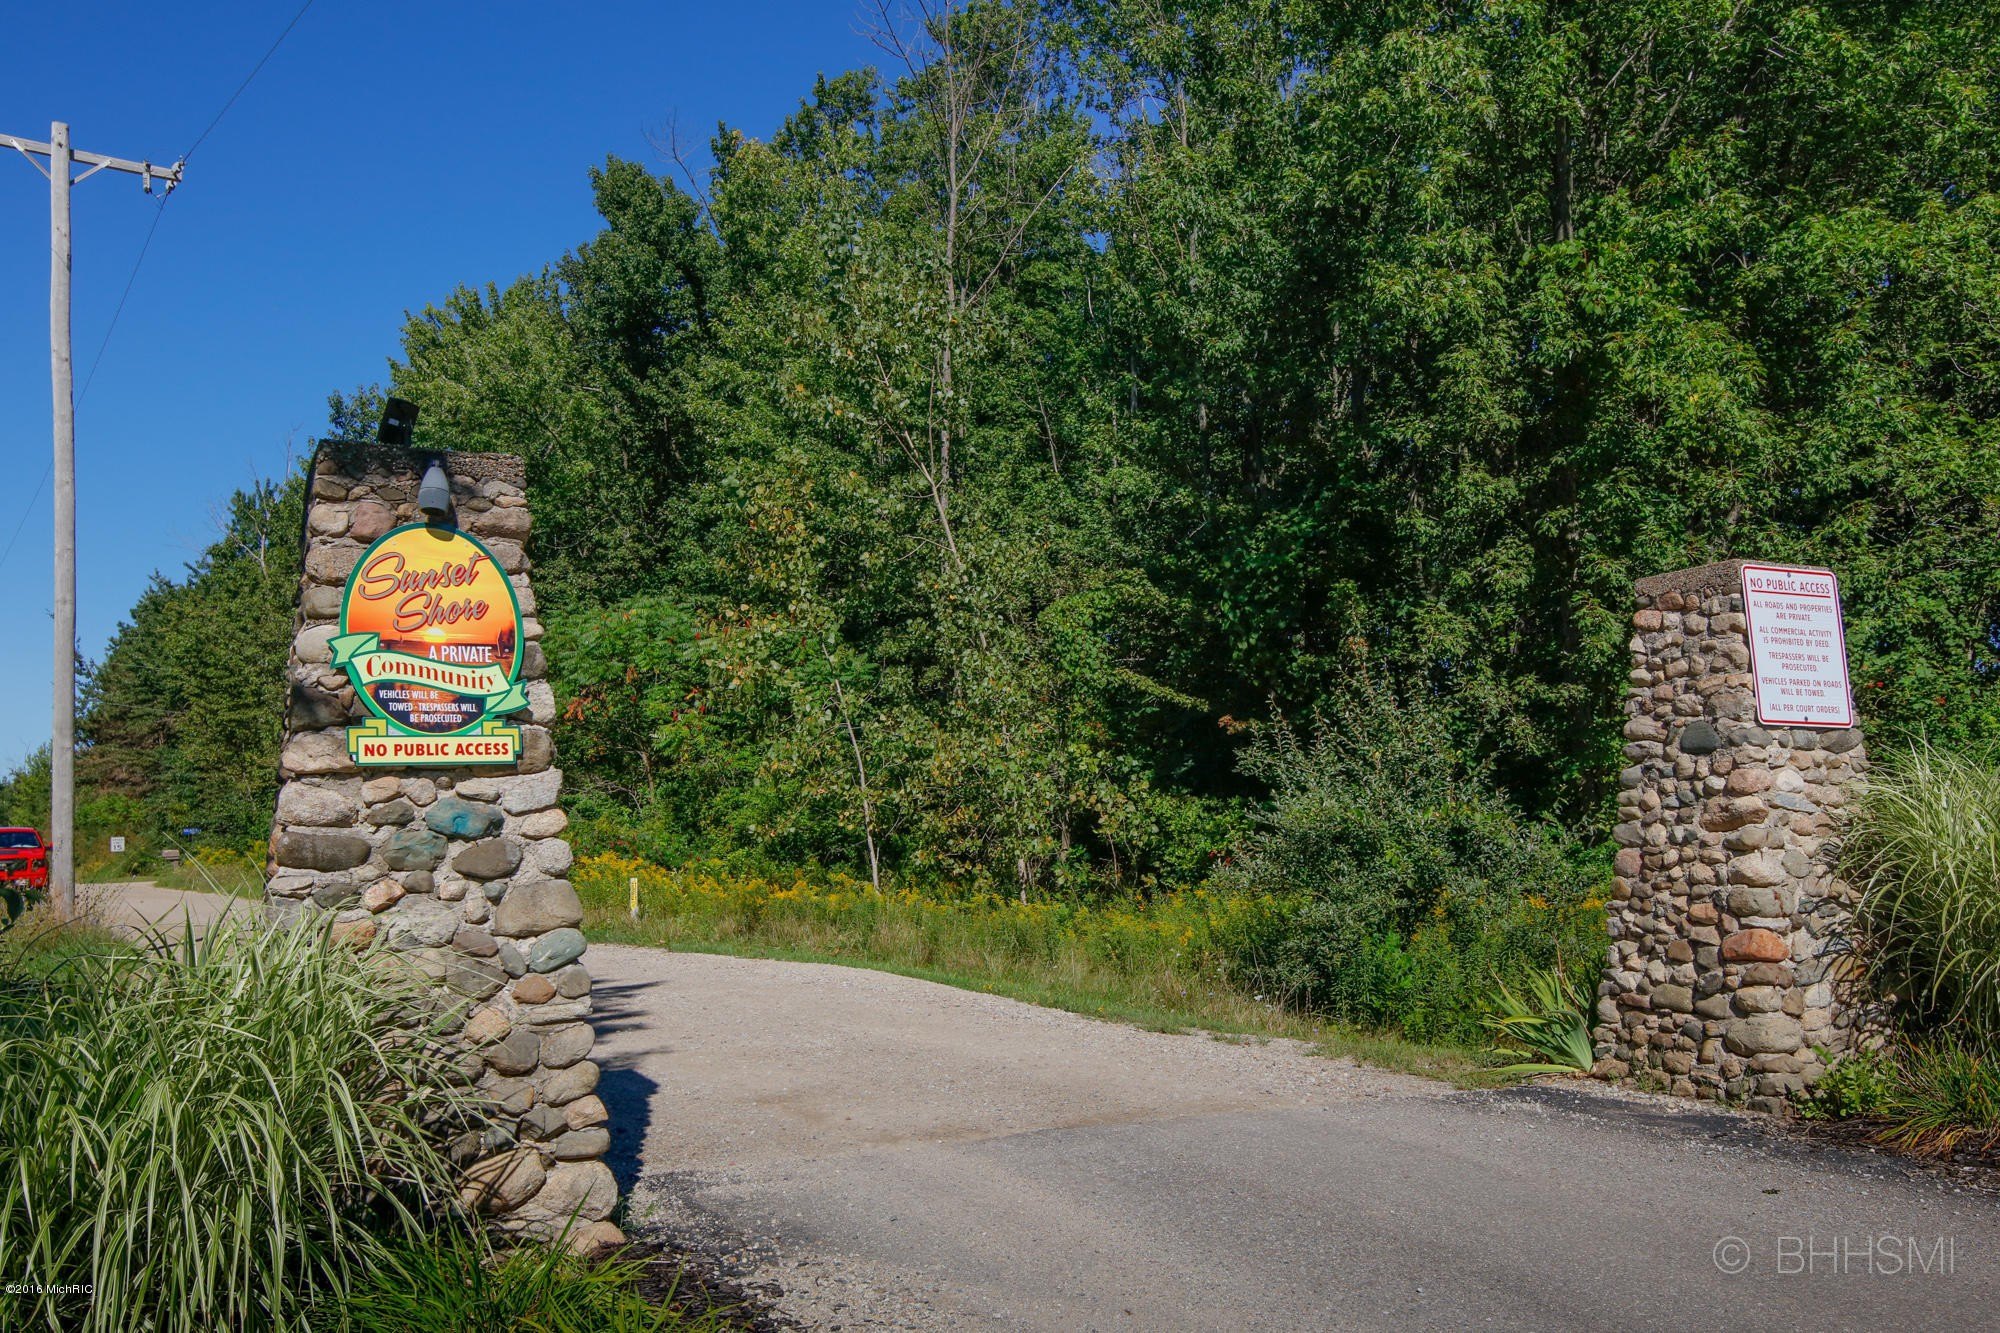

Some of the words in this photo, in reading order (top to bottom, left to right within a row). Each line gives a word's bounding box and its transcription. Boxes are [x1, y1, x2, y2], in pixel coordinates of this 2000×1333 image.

[358, 552, 490, 600] Sunset
[1750, 577, 1763, 589] NO
[1766, 578, 1797, 592] PUBLIC
[1799, 581, 1830, 594] ACCESS
[393, 590, 489, 633] Shore
[1753, 600, 1763, 608] ALL
[1764, 601, 1784, 610] ROADS
[1785, 603, 1798, 611] AND
[1799, 603, 1833, 614] PROPERTIES
[1775, 612, 1787, 620] ARE
[1759, 626, 1769, 634] ALL
[1770, 626, 1807, 637] COMMERCIAL
[1808, 629, 1832, 638] ACTIVITY
[1763, 636, 1769, 644] IS
[1770, 636, 1804, 647] PROHIBITED
[1805, 639, 1813, 647] BY
[428, 645, 438, 661] A
[441, 646, 493, 662] PRIVATE
[1768, 651, 1805, 661] TRESPASSERS
[1806, 654, 1820, 662] WILL
[1821, 655, 1829, 663] BE
[366, 654, 497, 693] Community
[1761, 677, 1787, 686] VEHICLES
[1789, 678, 1811, 687] PARKED
[1812, 679, 1821, 687] ON
[1823, 680, 1842, 689] ROADS
[378, 689, 410, 699] VEHICLES
[411, 690, 428, 699] WILL
[429, 690, 439, 699] BE
[1780, 687, 1794, 696] WILL
[1795, 688, 1803, 697] BE
[388, 702, 413, 712] TOWED
[418, 702, 459, 712] TRESPASSERS
[460, 703, 477, 712] WILL
[1783, 704, 1794, 712] PER
[1795, 704, 1815, 713] COURT
[409, 713, 419, 722] BE
[420, 713, 462, 723] PROSECUTED
[363, 744, 388, 757] NO
[393, 743, 449, 757] PUBLIC
[455, 742, 509, 756] ACCESS
